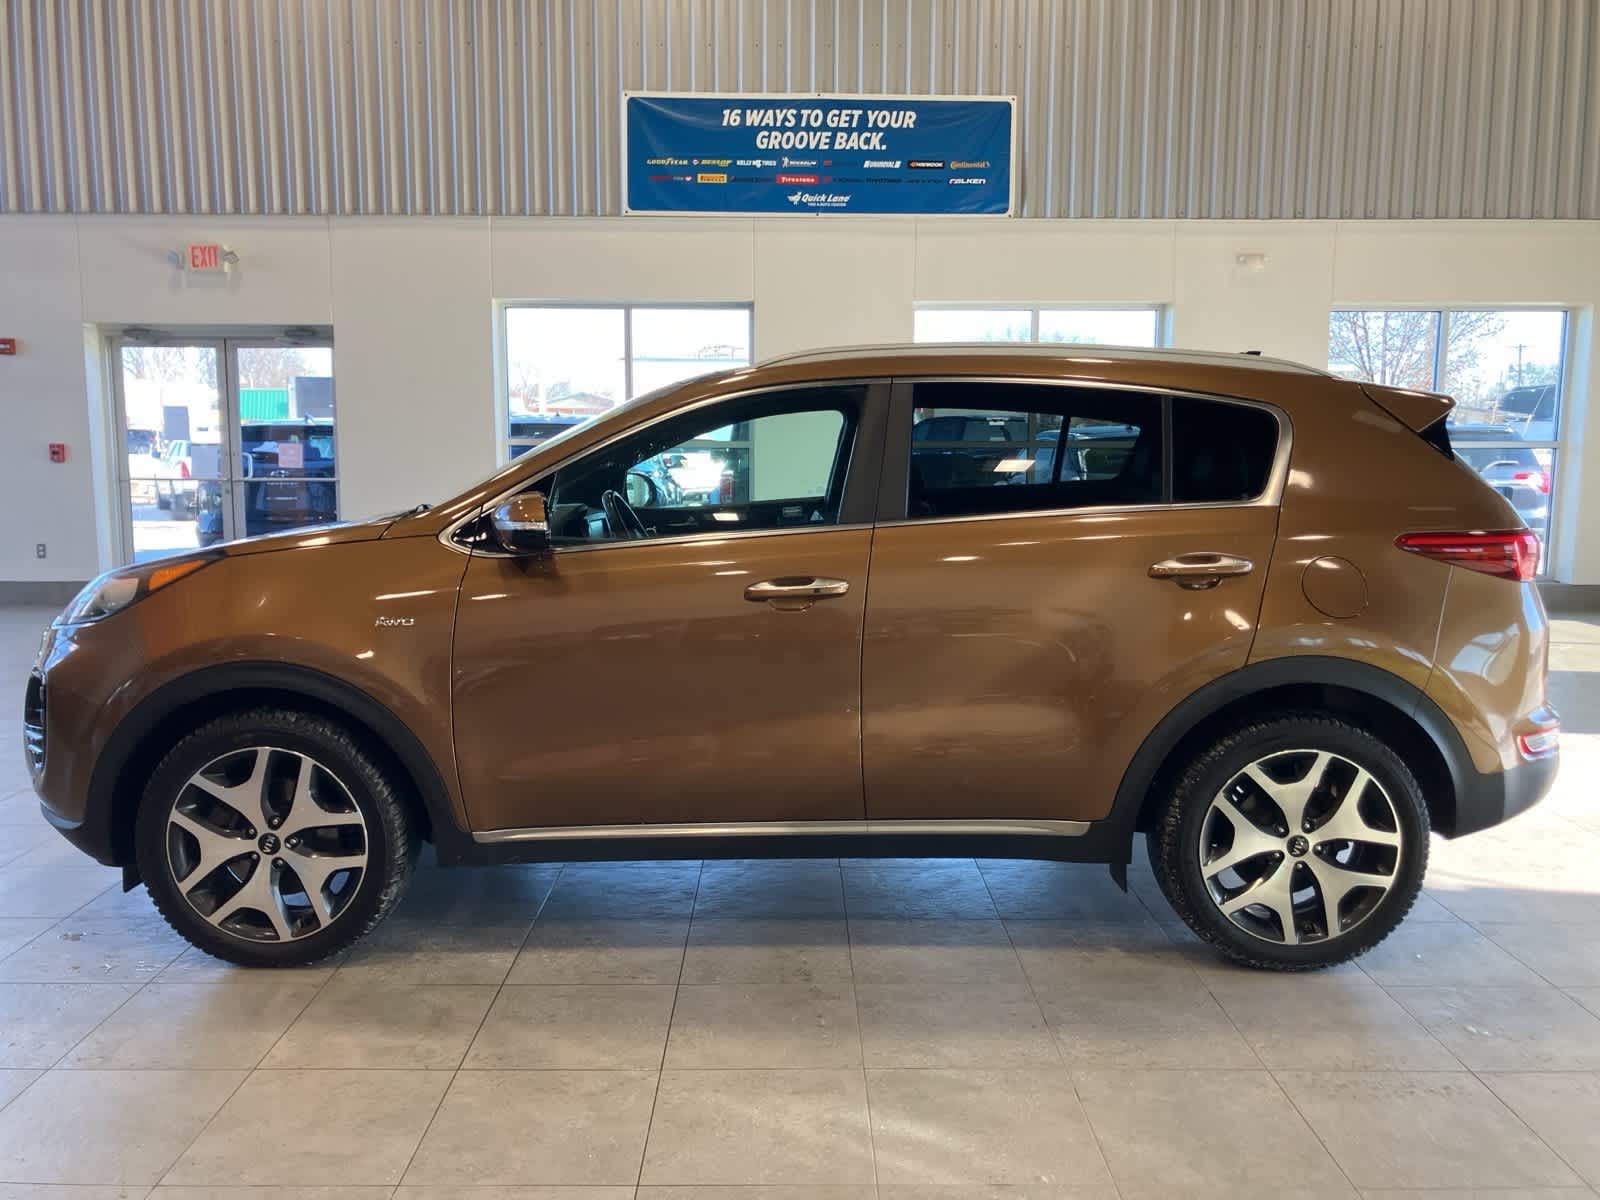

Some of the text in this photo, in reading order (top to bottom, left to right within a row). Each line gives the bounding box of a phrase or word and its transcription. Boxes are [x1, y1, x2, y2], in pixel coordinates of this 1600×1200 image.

[722, 109, 917, 128] 16 WAYS TO GET YOUR
[756, 131, 887, 150] GROOVE BACK.
[646, 157, 688, 165] GOODYEAR
[801, 193, 851, 203] Quick Lane
[191, 244, 218, 268] EXIT
